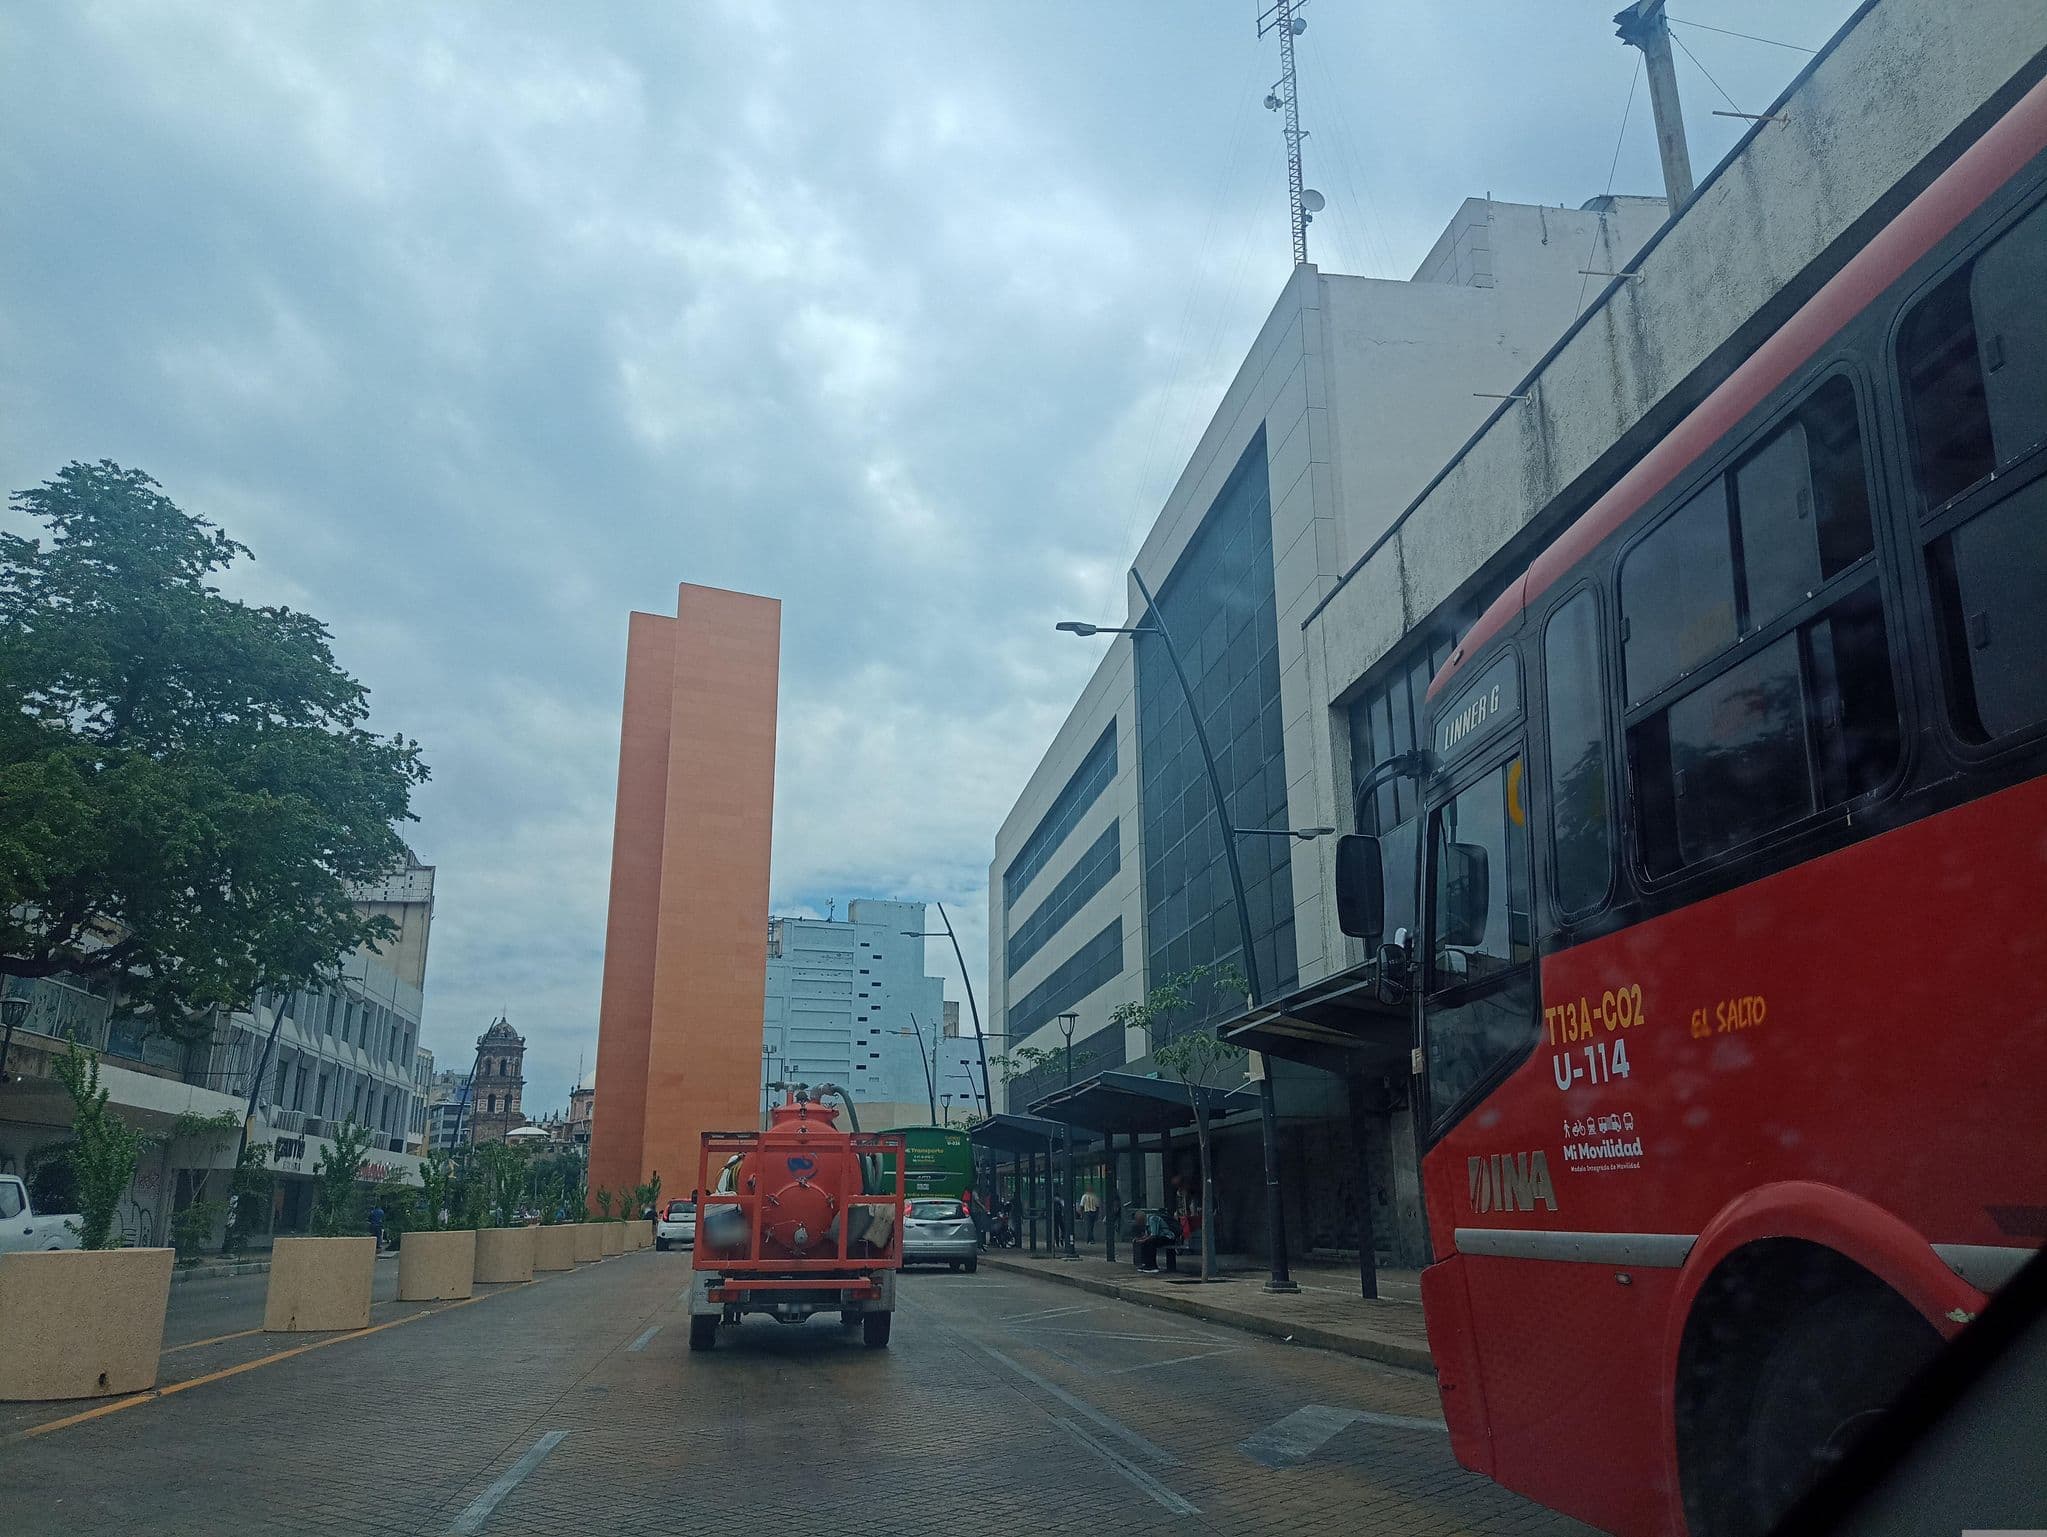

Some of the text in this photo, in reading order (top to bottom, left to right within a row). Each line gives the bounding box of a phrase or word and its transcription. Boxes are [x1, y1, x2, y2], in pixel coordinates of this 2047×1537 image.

[1445, 685, 1499, 751] LINNER G
[1691, 995, 1767, 1040] EL SALTO
[1553, 1038, 1630, 1091] U-114
[1563, 1136, 1643, 1161] Mi Movilidad
[1467, 1150, 1559, 1214] DINA
